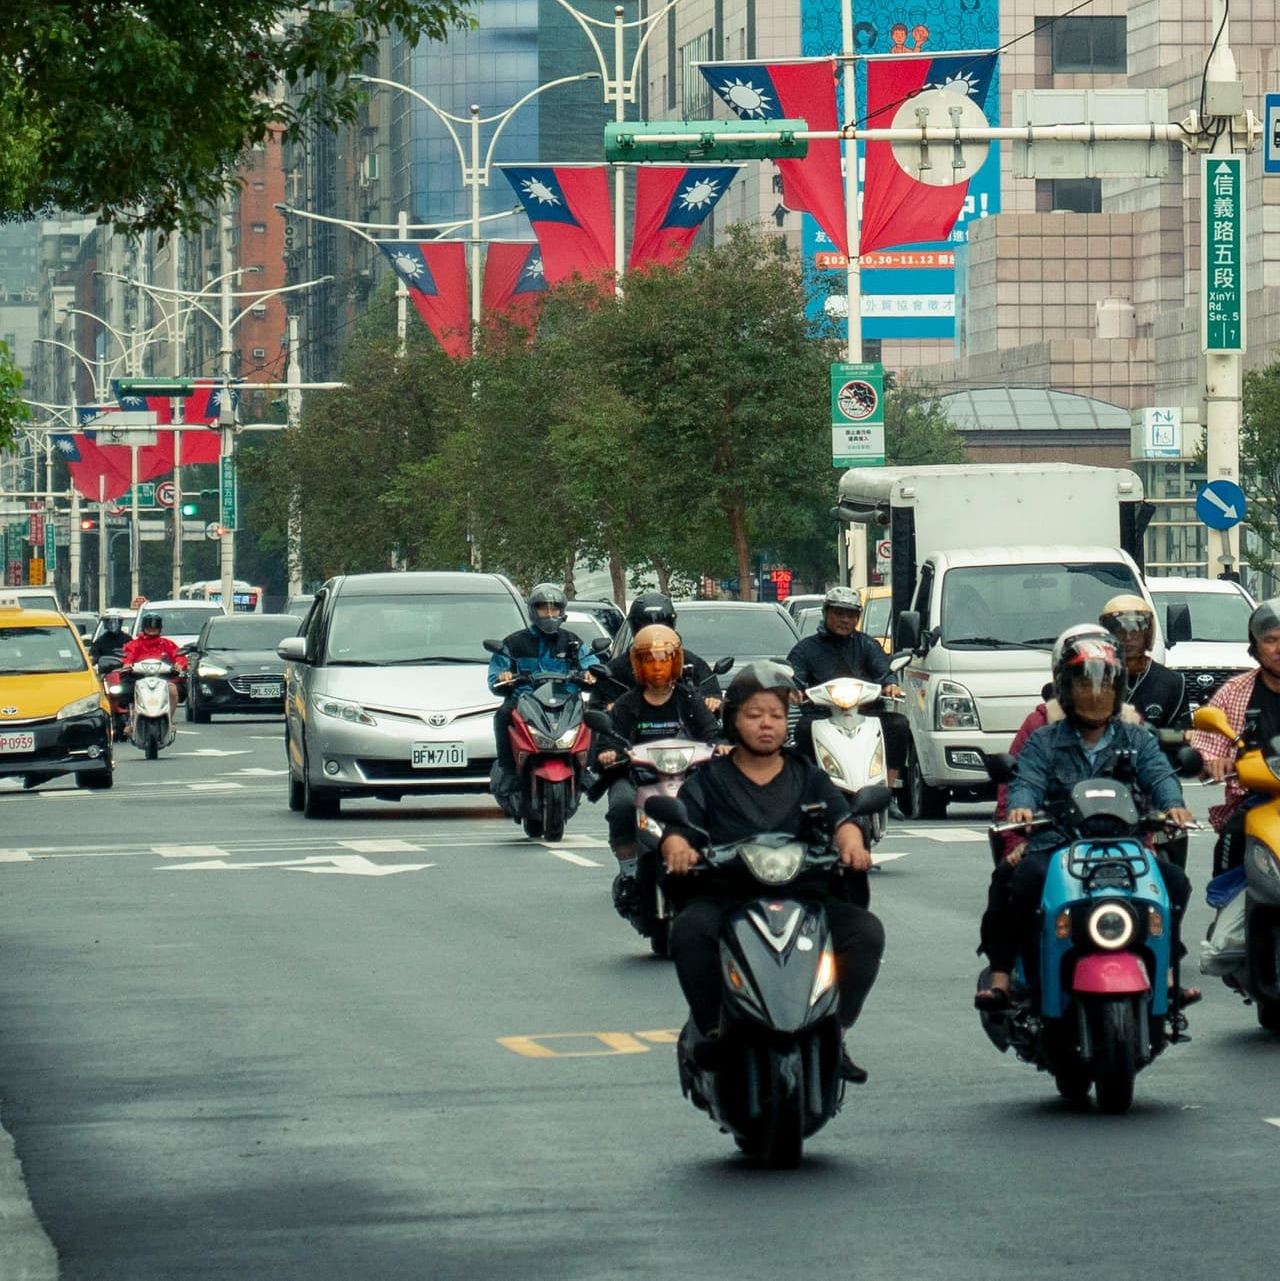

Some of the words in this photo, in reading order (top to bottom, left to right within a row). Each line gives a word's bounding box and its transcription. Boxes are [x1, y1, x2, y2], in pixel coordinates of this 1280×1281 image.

[1213, 174, 1235, 289] 信義路五段
[1209, 291, 1235, 301] XinYi
[1208, 301, 1224, 312] Rd.
[1209, 311, 1231, 322] Sec.
[1232, 311, 1240, 322] 5
[413, 749, 464, 765] BFM-7101
